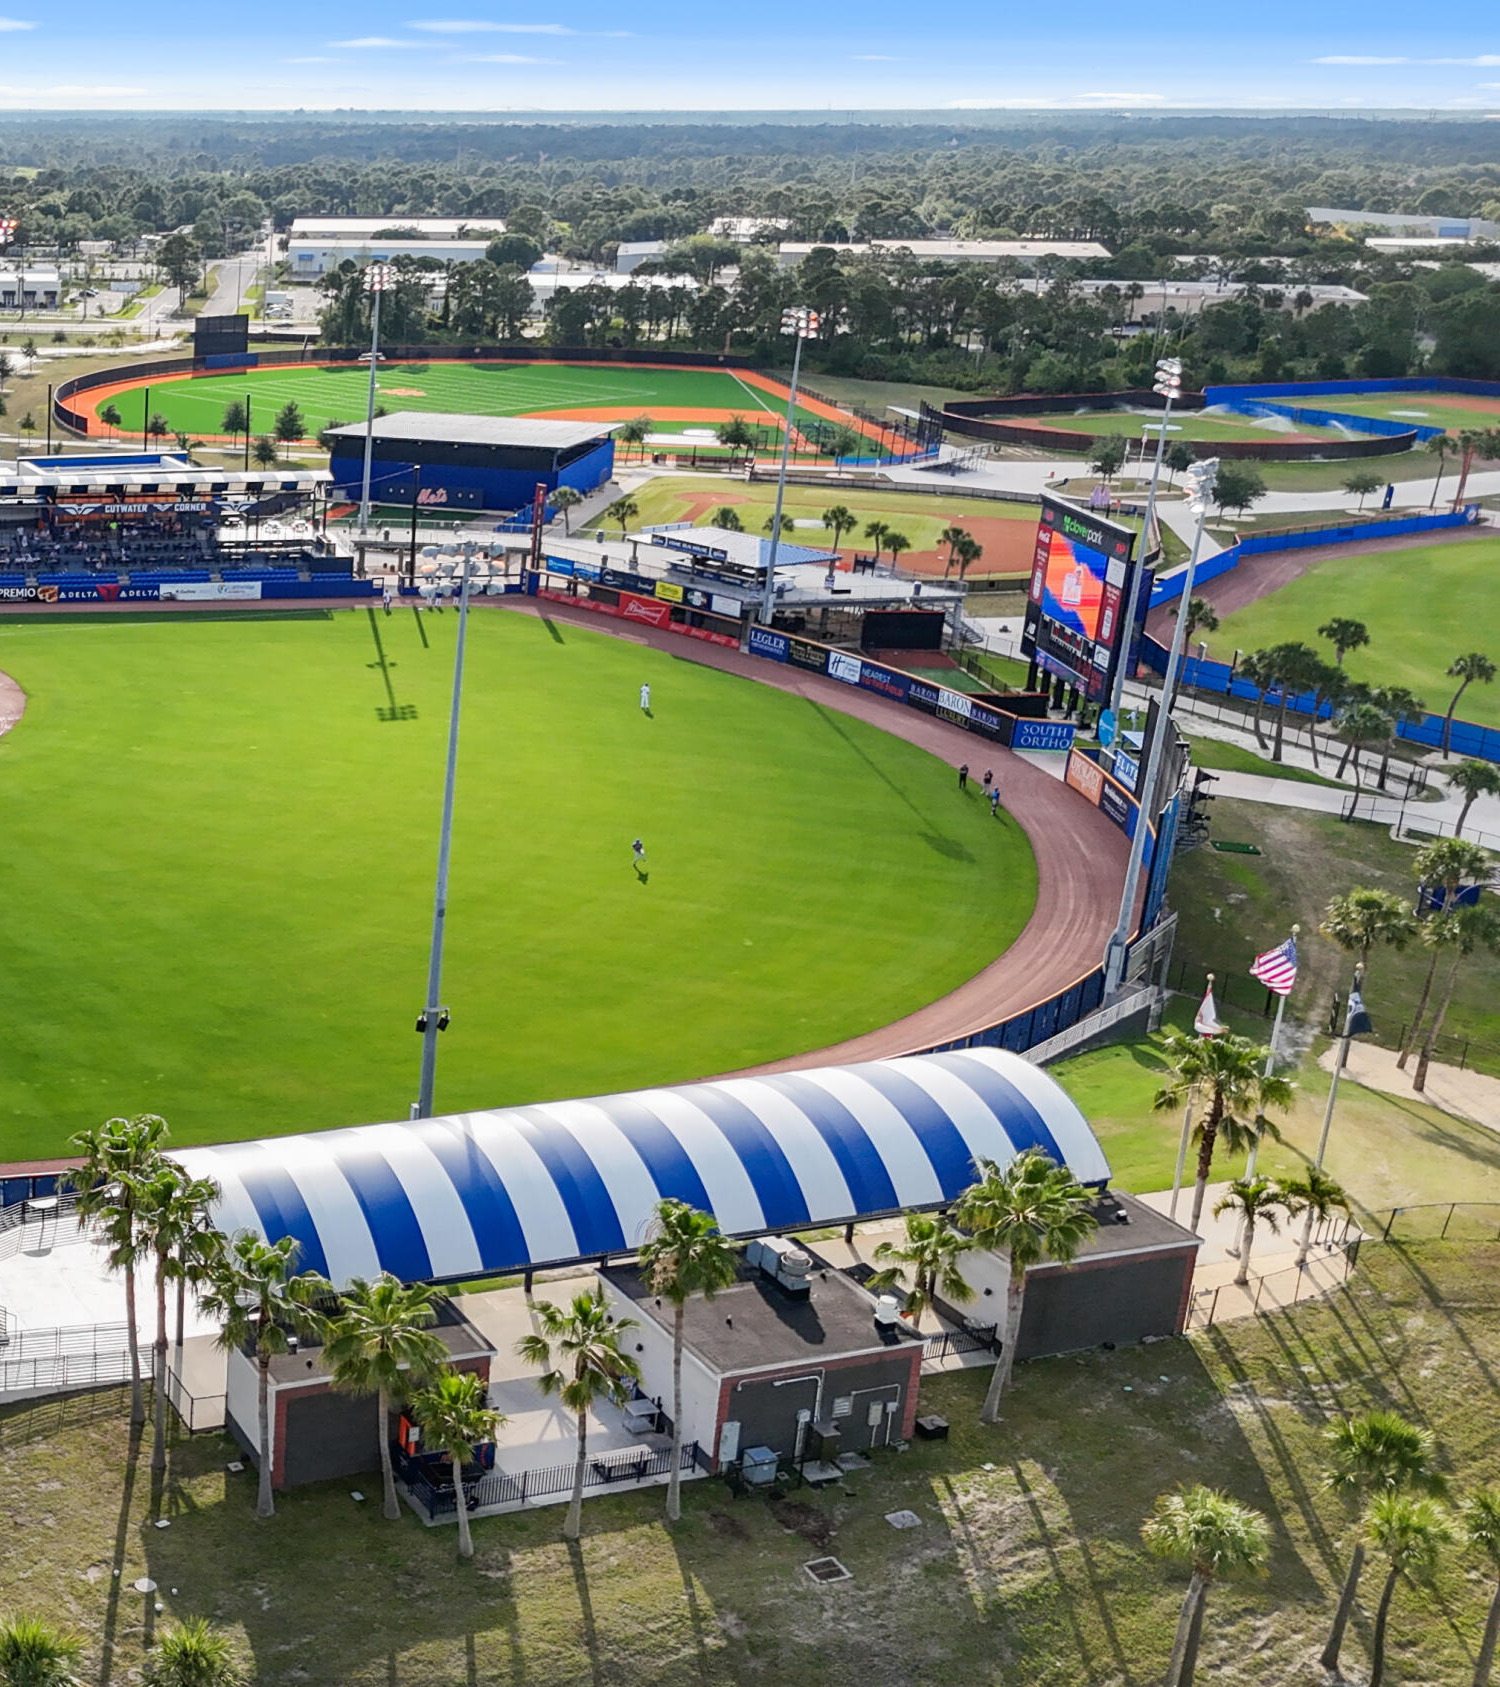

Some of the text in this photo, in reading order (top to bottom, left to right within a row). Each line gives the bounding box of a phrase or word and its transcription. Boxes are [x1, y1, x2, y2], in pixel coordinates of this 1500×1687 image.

[416, 488, 448, 505] Mets
[104, 502, 207, 513] CUTWATER CORNER
[68, 591, 98, 599] DELTA
[128, 589, 159, 597] DELTA
[750, 630, 786, 650] LEGLER
[861, 668, 891, 684] NEAREST
[910, 683, 938, 700] BARON
[938, 690, 970, 714] BARON
[971, 707, 998, 726] BARON
[1022, 724, 1068, 738] SOUTH
[1020, 735, 1070, 749] ORTHO
